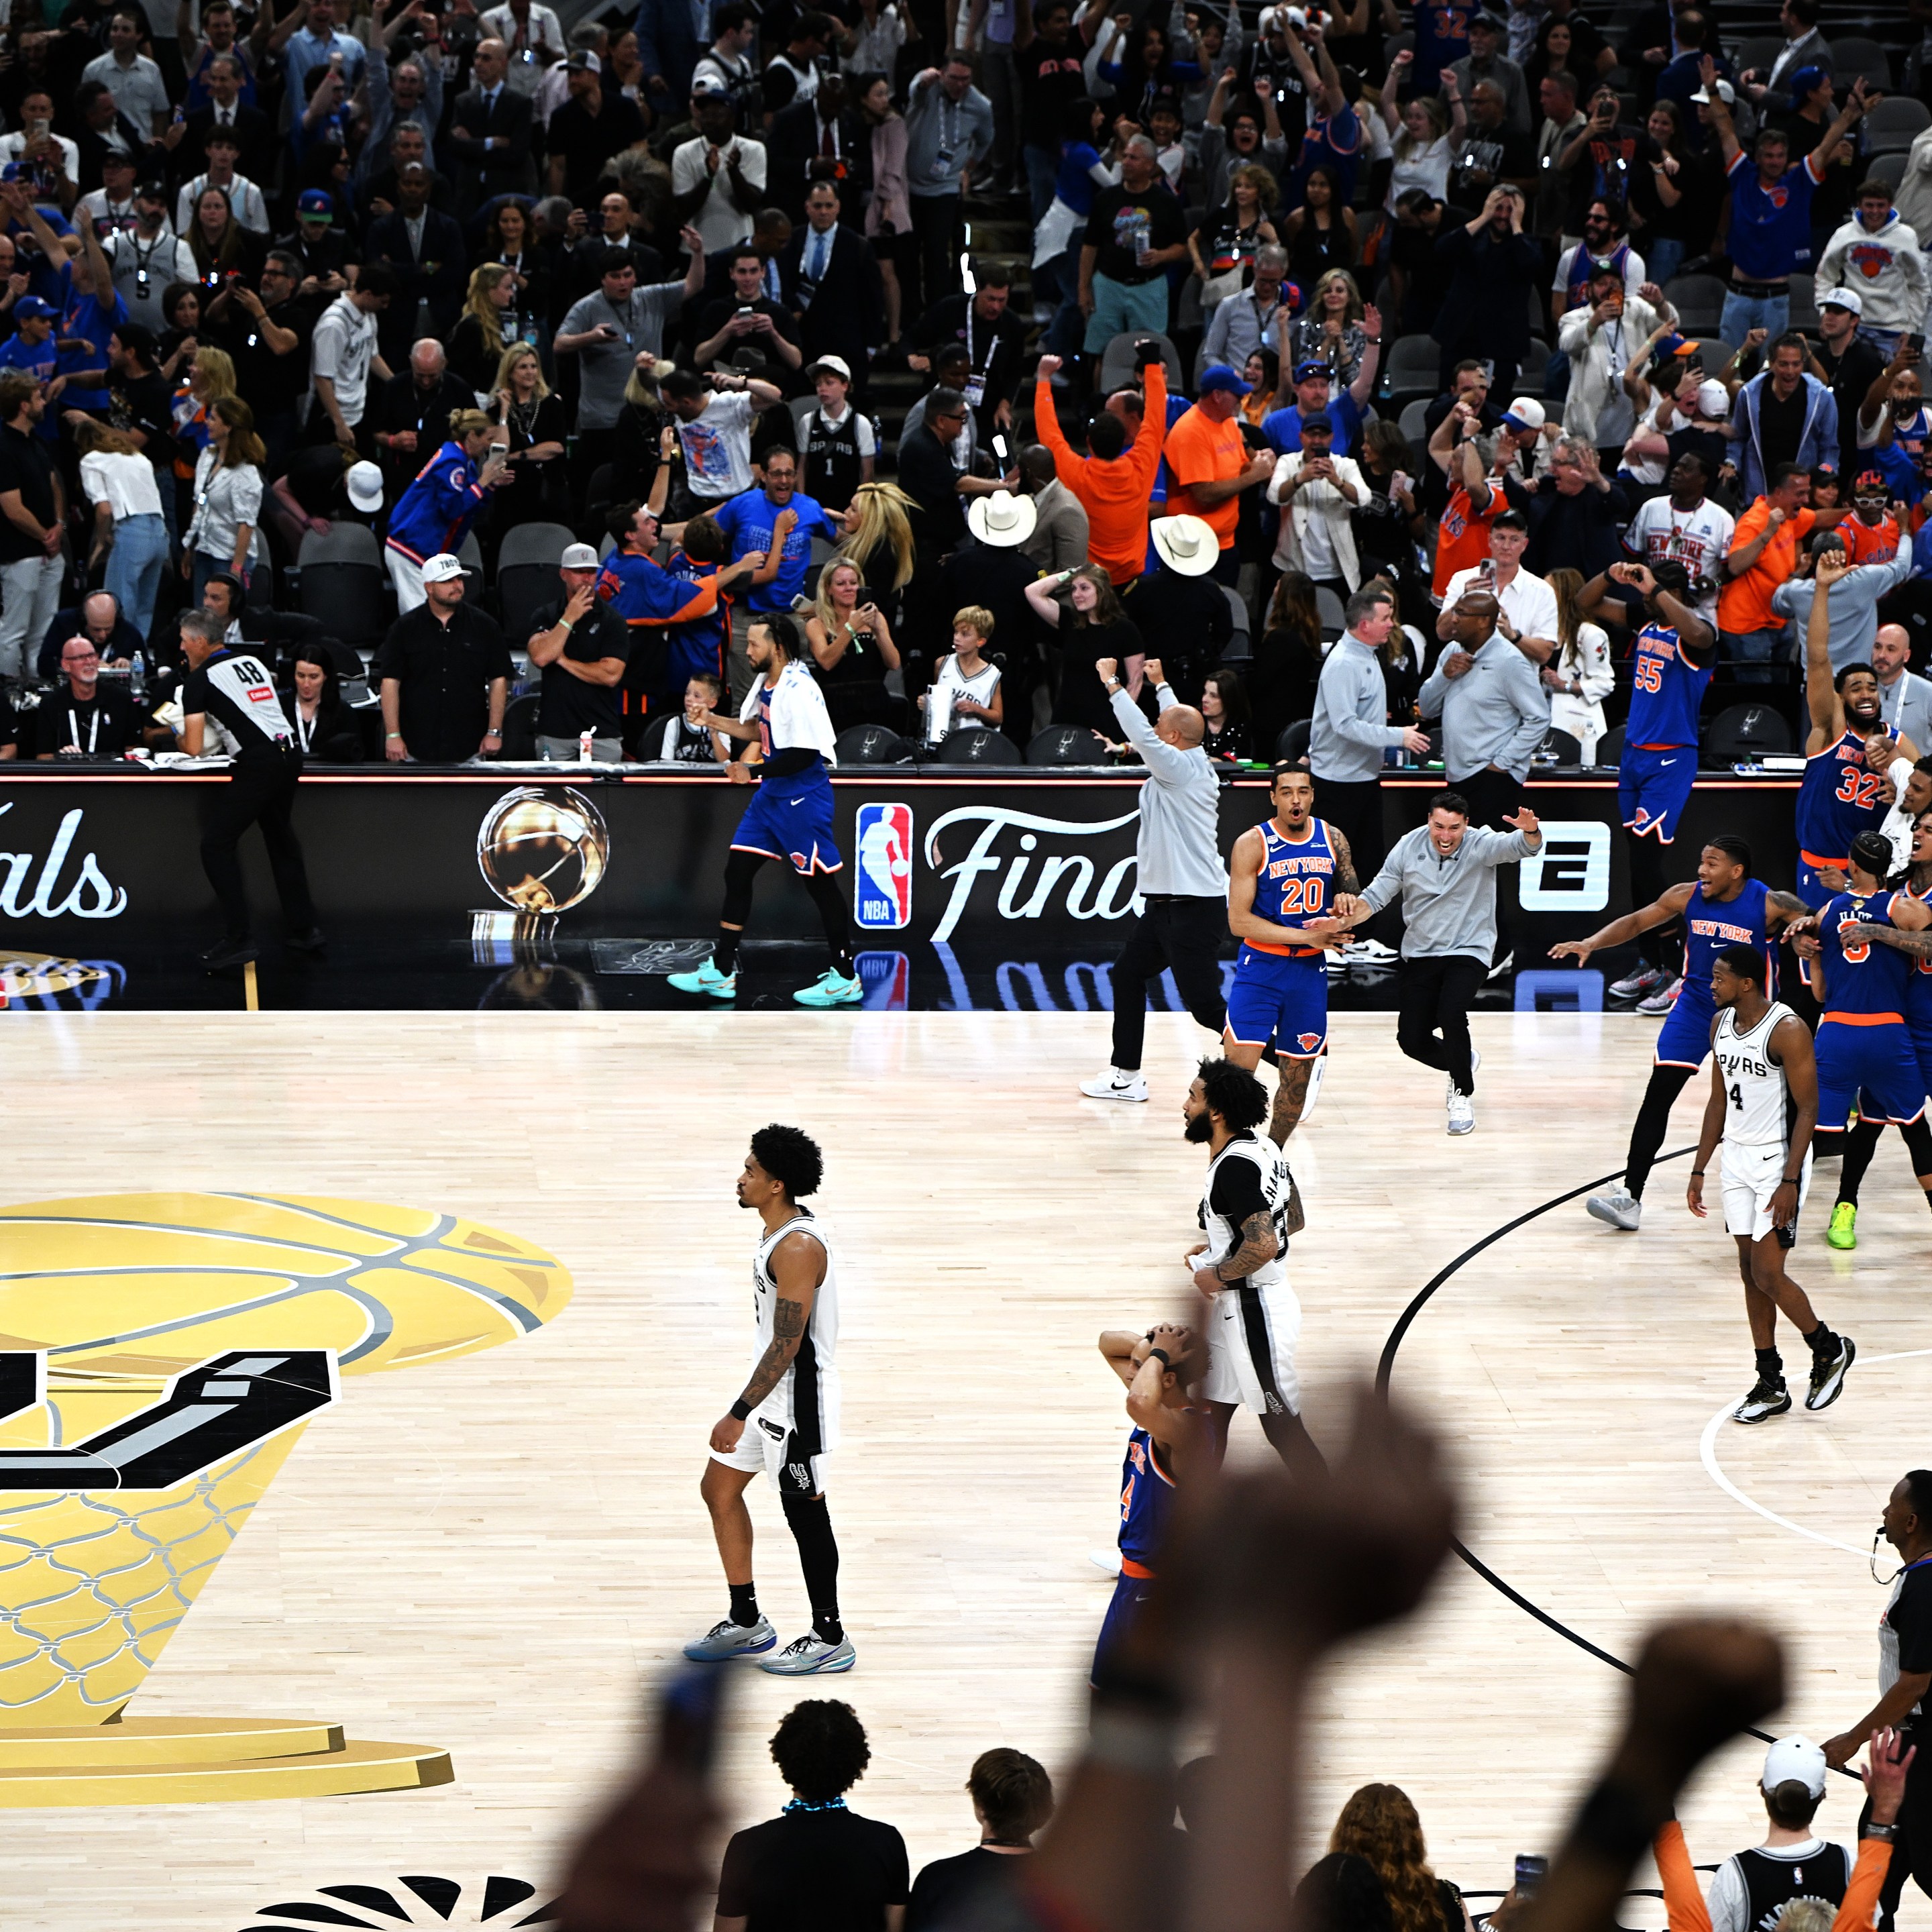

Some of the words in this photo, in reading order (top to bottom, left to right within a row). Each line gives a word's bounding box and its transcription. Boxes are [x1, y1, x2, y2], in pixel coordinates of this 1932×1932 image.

[1434, 10, 1467, 39] 32
[825, 458, 835, 476] 1
[1651, 641, 1676, 661] YORK
[231, 661, 264, 685] 48
[1635, 654, 1665, 694] 55
[1835, 745, 1866, 764] NEW
[1835, 766, 1880, 810] 32
[1269, 858, 1301, 879] NEW
[1299, 856, 1334, 875] YORK
[1281, 877, 1325, 915] 20
[863, 900, 890, 920] NBA
[1690, 920, 1719, 936] NEW
[1717, 922, 1754, 945] YORK
[1729, 1081, 1744, 1112] 4
